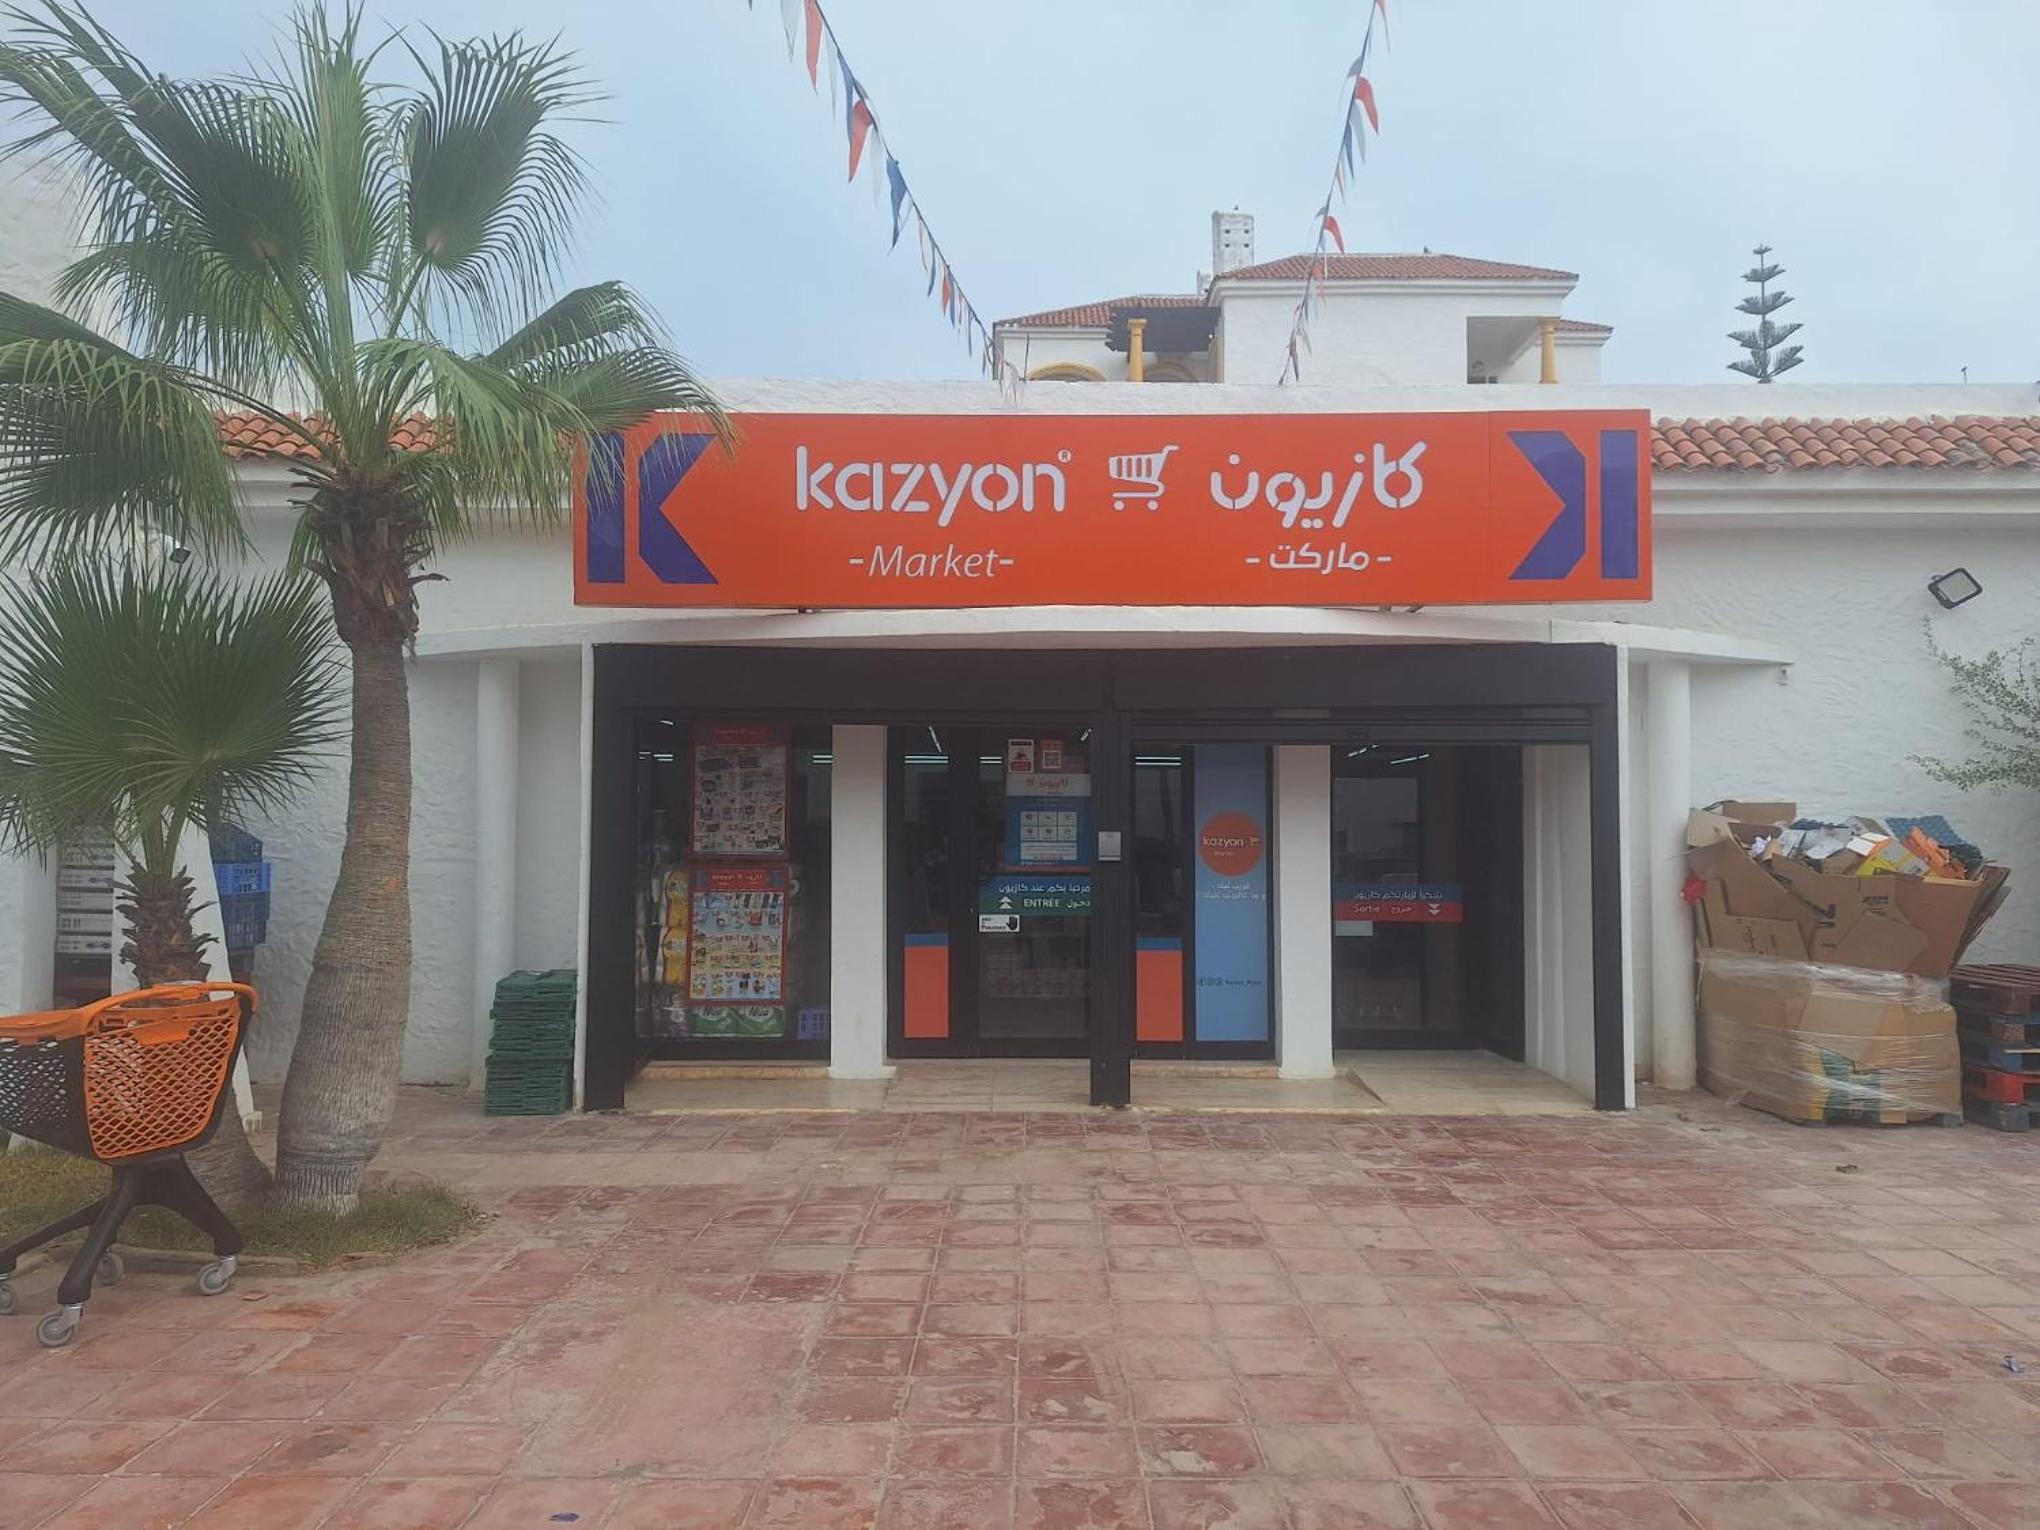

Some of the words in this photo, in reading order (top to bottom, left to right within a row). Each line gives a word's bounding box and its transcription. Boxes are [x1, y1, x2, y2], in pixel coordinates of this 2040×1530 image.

[796, 445, 1066, 528] kazyon
[1210, 441, 1427, 529] كازيون
[1202, 835, 1244, 848] kazyon
[1353, 903, 1381, 914] Sortie
